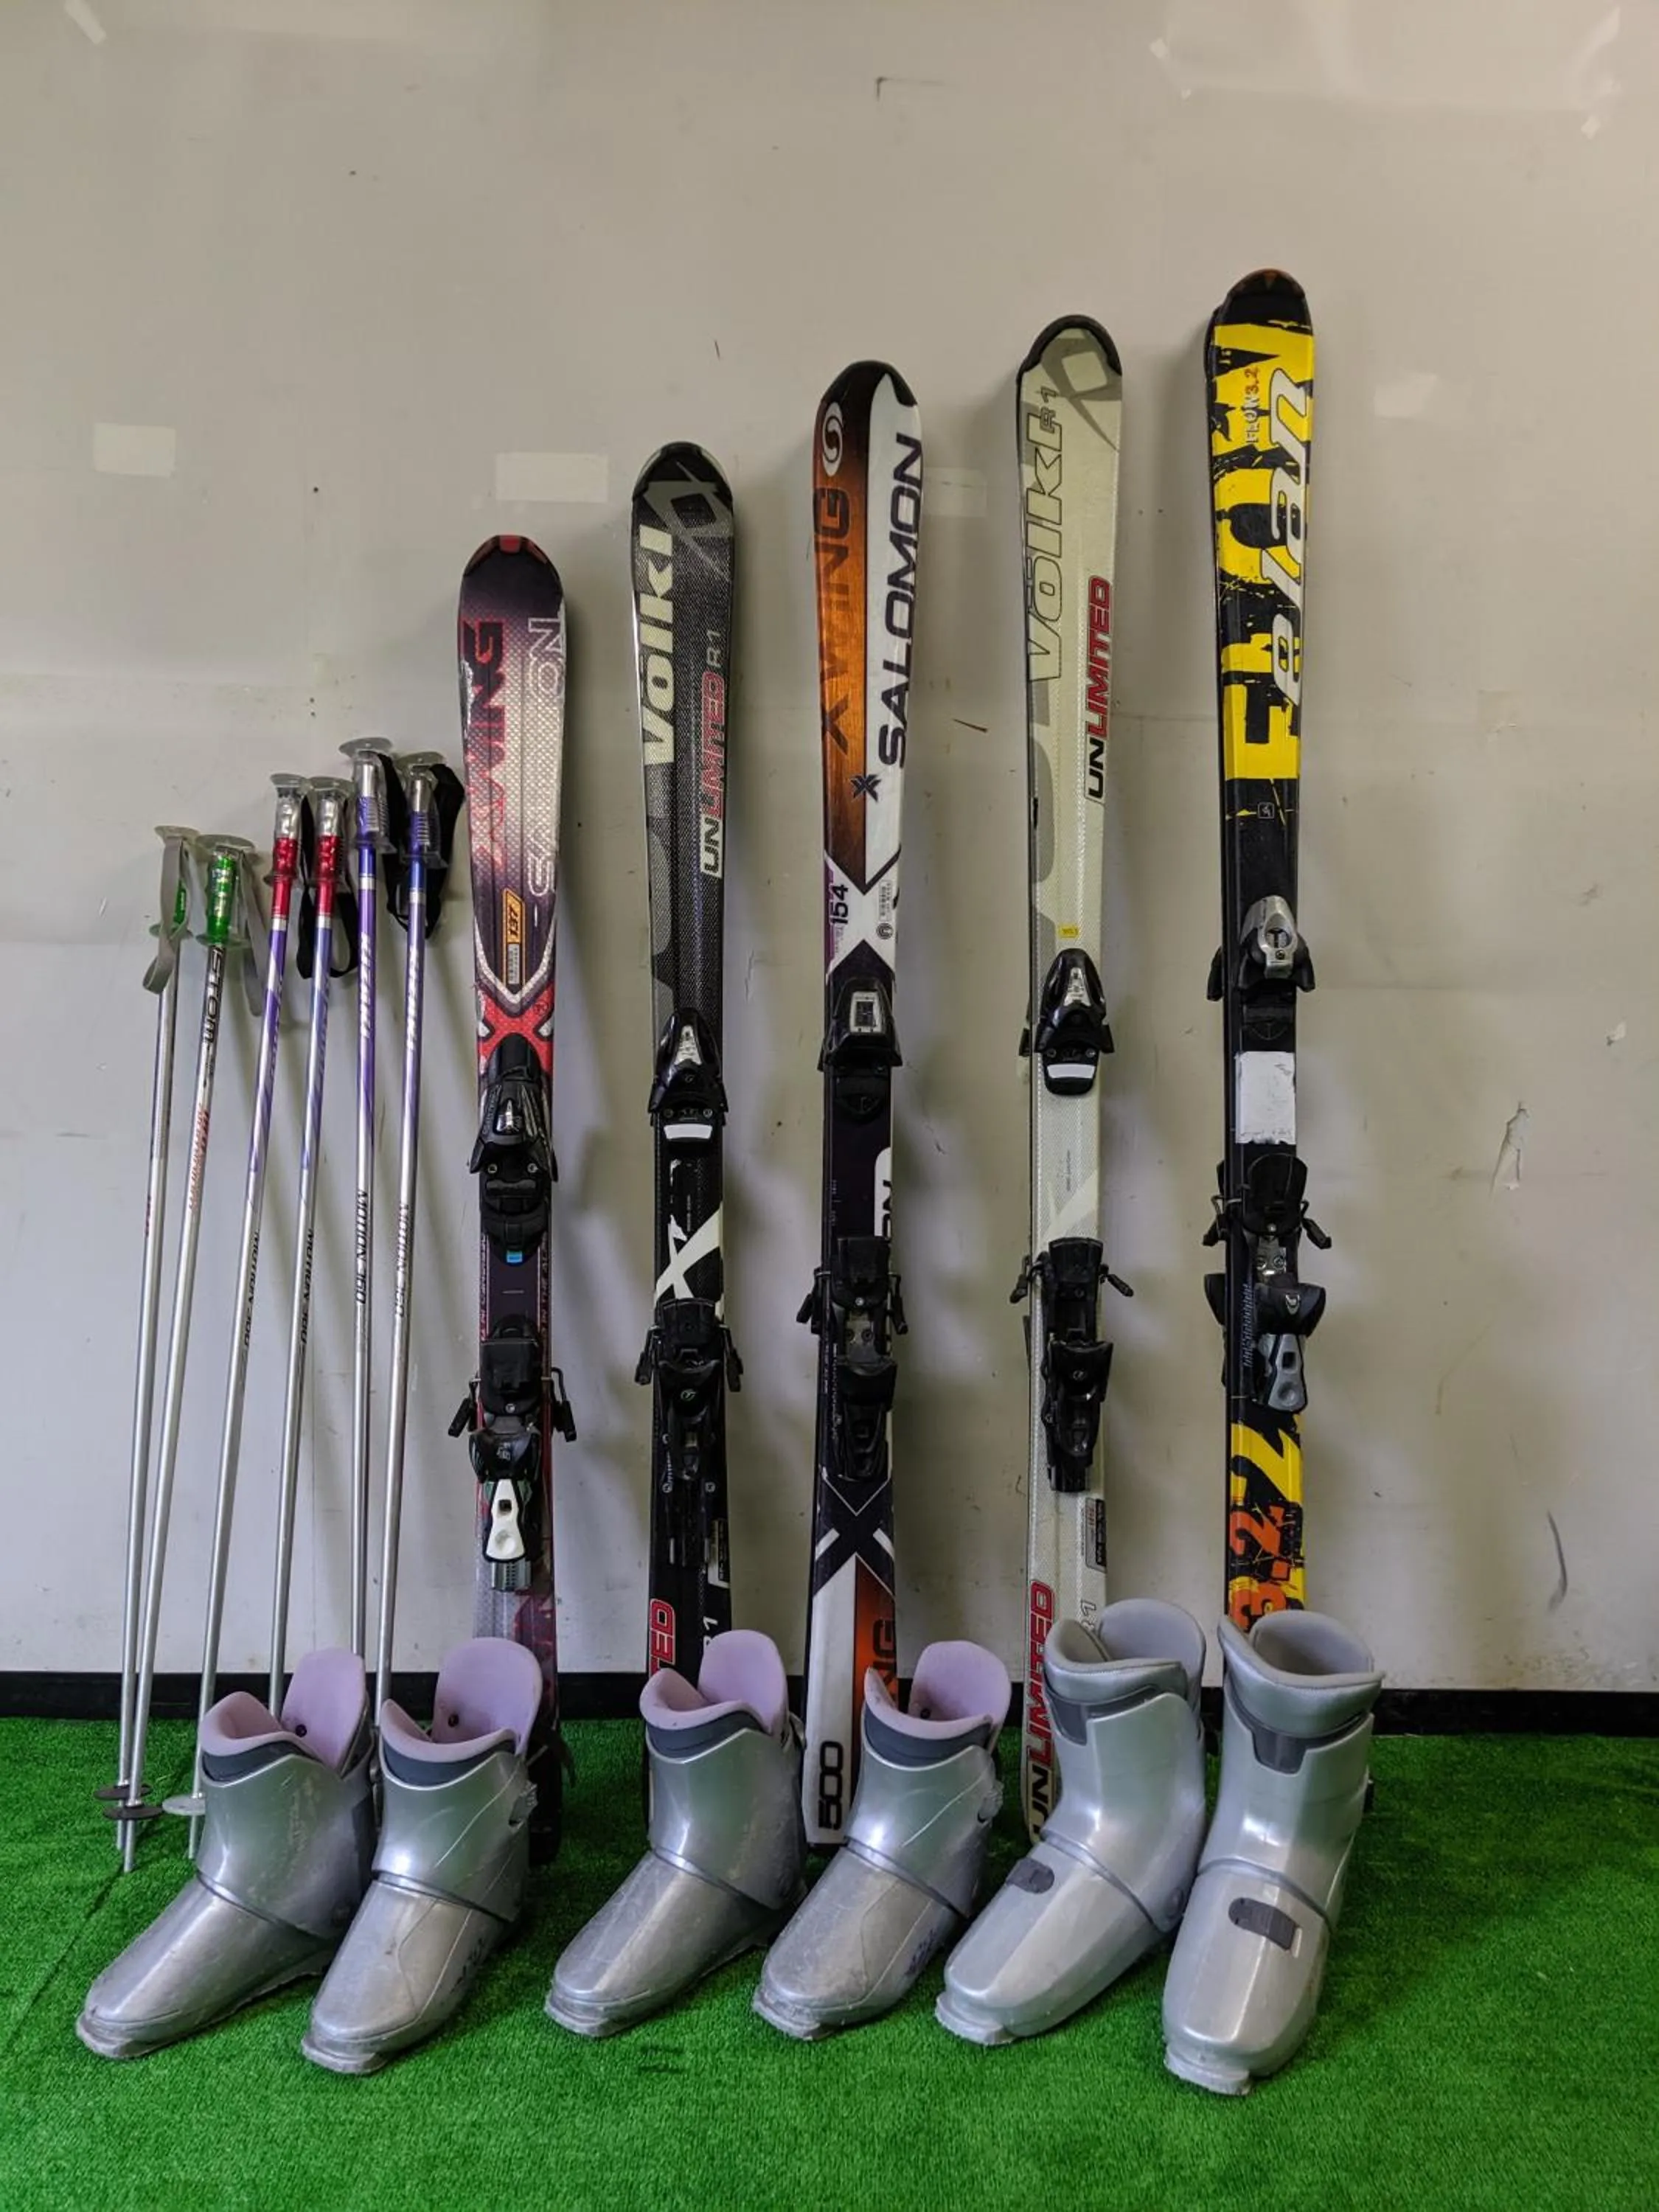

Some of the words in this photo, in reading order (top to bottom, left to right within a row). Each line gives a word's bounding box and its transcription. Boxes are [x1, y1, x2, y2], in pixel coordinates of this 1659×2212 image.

[879, 431, 922, 768] SALOMON
[1262, 367, 1307, 706] elan
[700, 671, 724, 878] UNLIMITED
[1087, 576, 1111, 800] UNLIMITED
[829, 883, 849, 927] 154
[818, 1740, 844, 1832] 500
